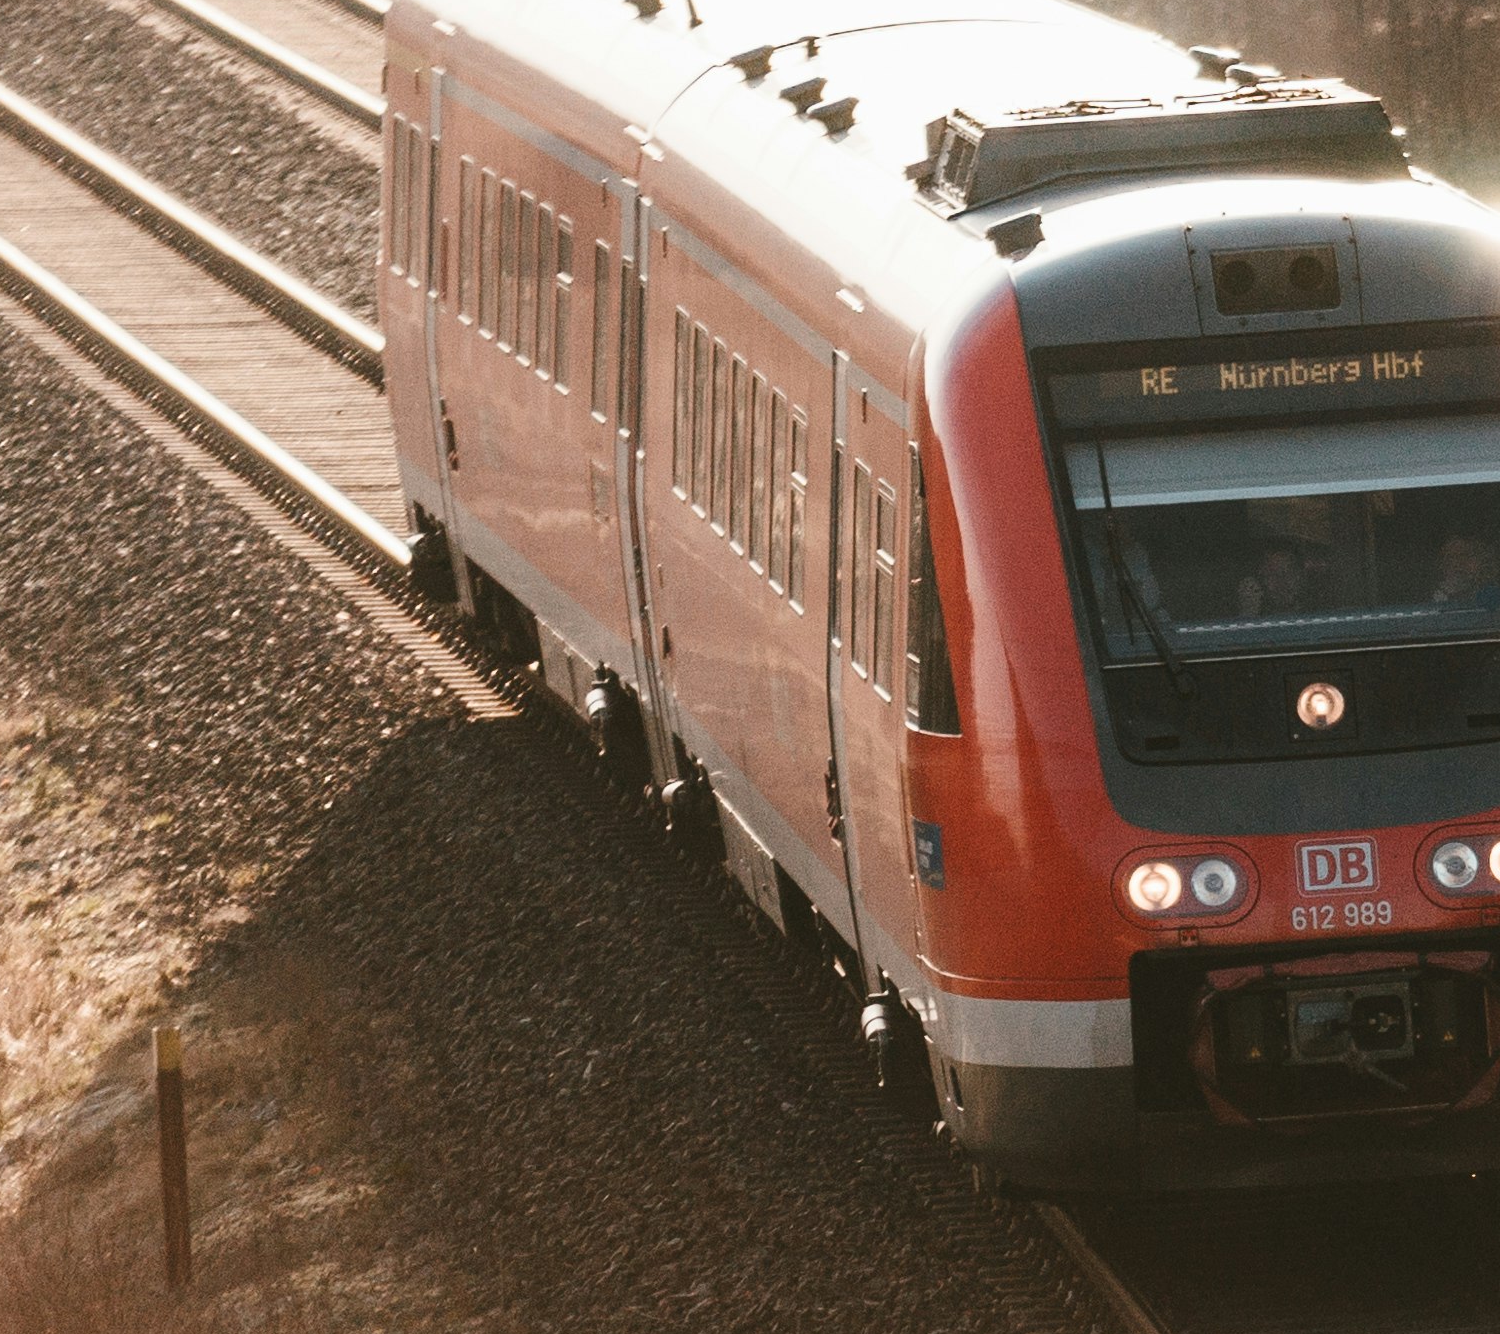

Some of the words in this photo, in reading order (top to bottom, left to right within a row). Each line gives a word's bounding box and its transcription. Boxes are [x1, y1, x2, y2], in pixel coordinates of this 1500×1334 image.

[1140, 366, 1179, 396] RE
[1219, 358, 1361, 391] Nürnberg
[1372, 350, 1424, 381] Hbf
[1306, 846, 1369, 887] DB
[1291, 905, 1336, 931] 612
[1344, 900, 1392, 927] 989
